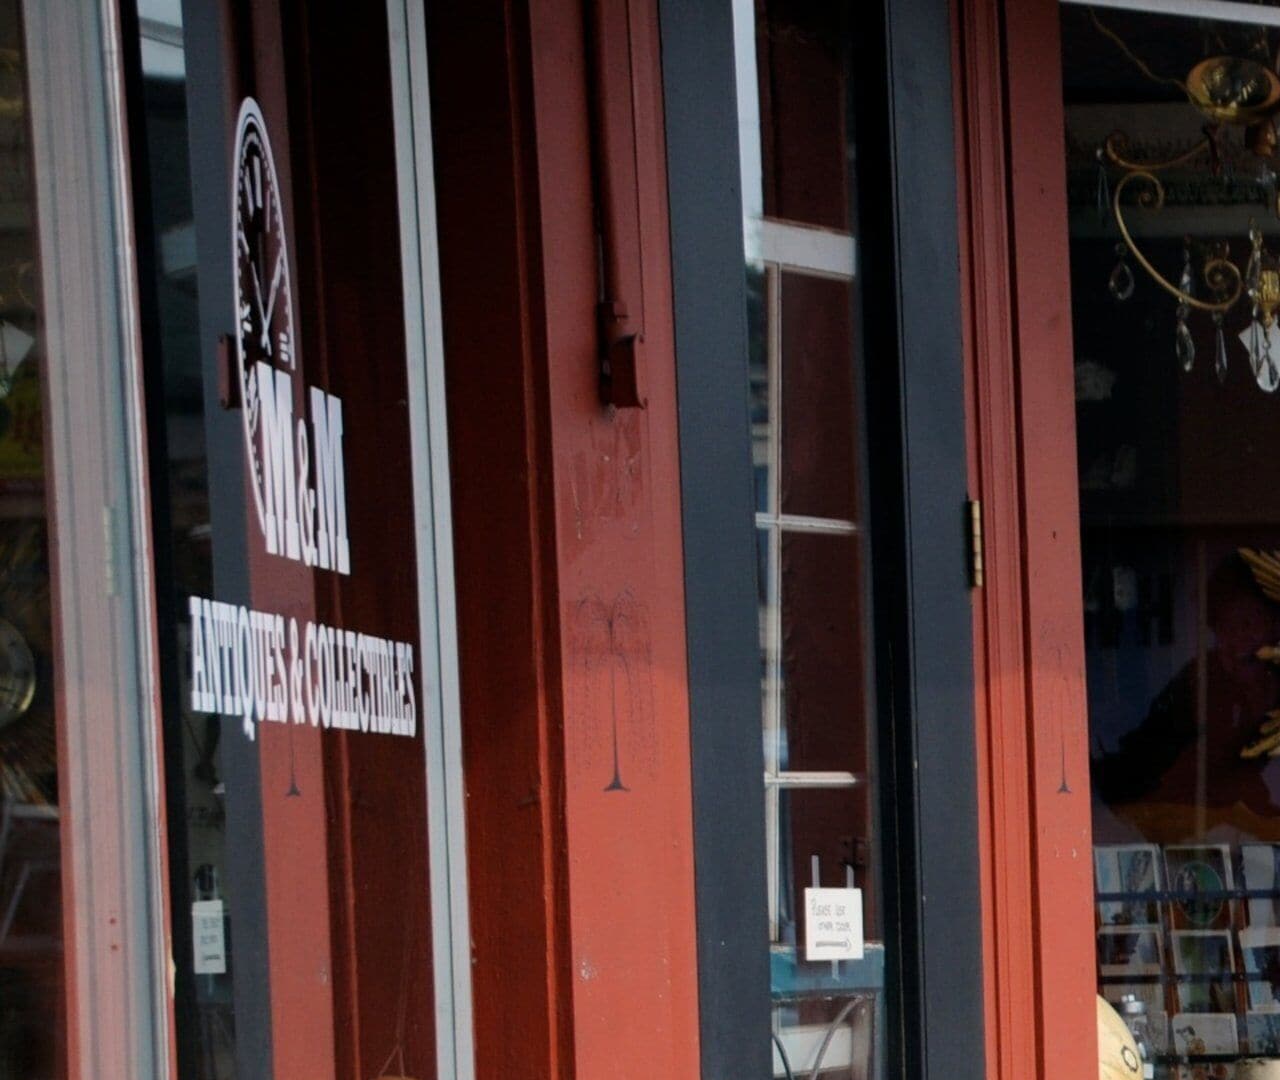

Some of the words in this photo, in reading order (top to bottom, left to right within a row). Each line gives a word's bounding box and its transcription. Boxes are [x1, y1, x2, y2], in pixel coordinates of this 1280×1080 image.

[190, 596, 288, 740] ANTIQUES
[290, 617, 306, 725] &
[305, 621, 416, 737] COLLECTIBLES
